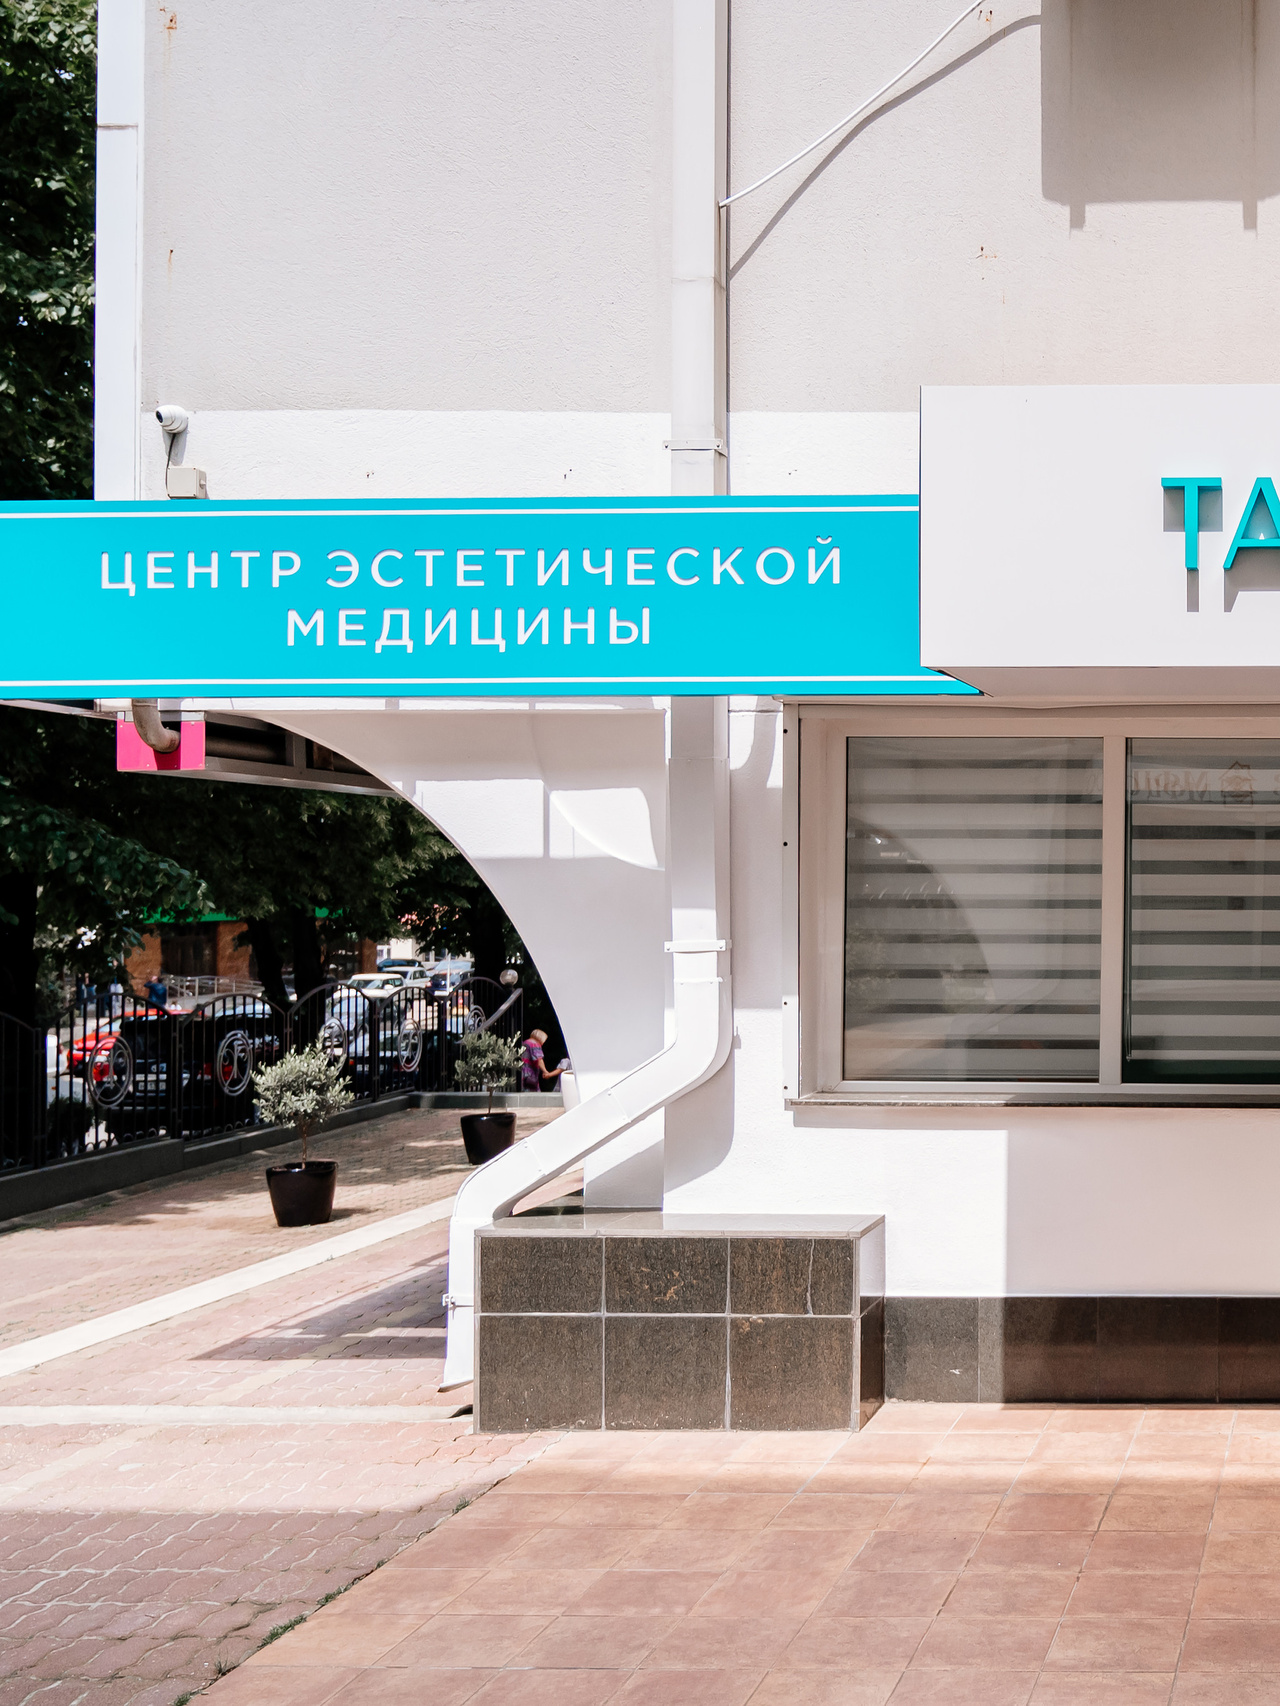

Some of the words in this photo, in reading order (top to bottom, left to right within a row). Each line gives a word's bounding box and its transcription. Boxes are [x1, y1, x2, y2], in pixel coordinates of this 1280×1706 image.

[100, 550, 302, 597] ЦЕНТР
[326, 536, 842, 588] ЭСТЕТИЧЕСКОЙ
[286, 606, 651, 654] МЕДИЦИНЫ
